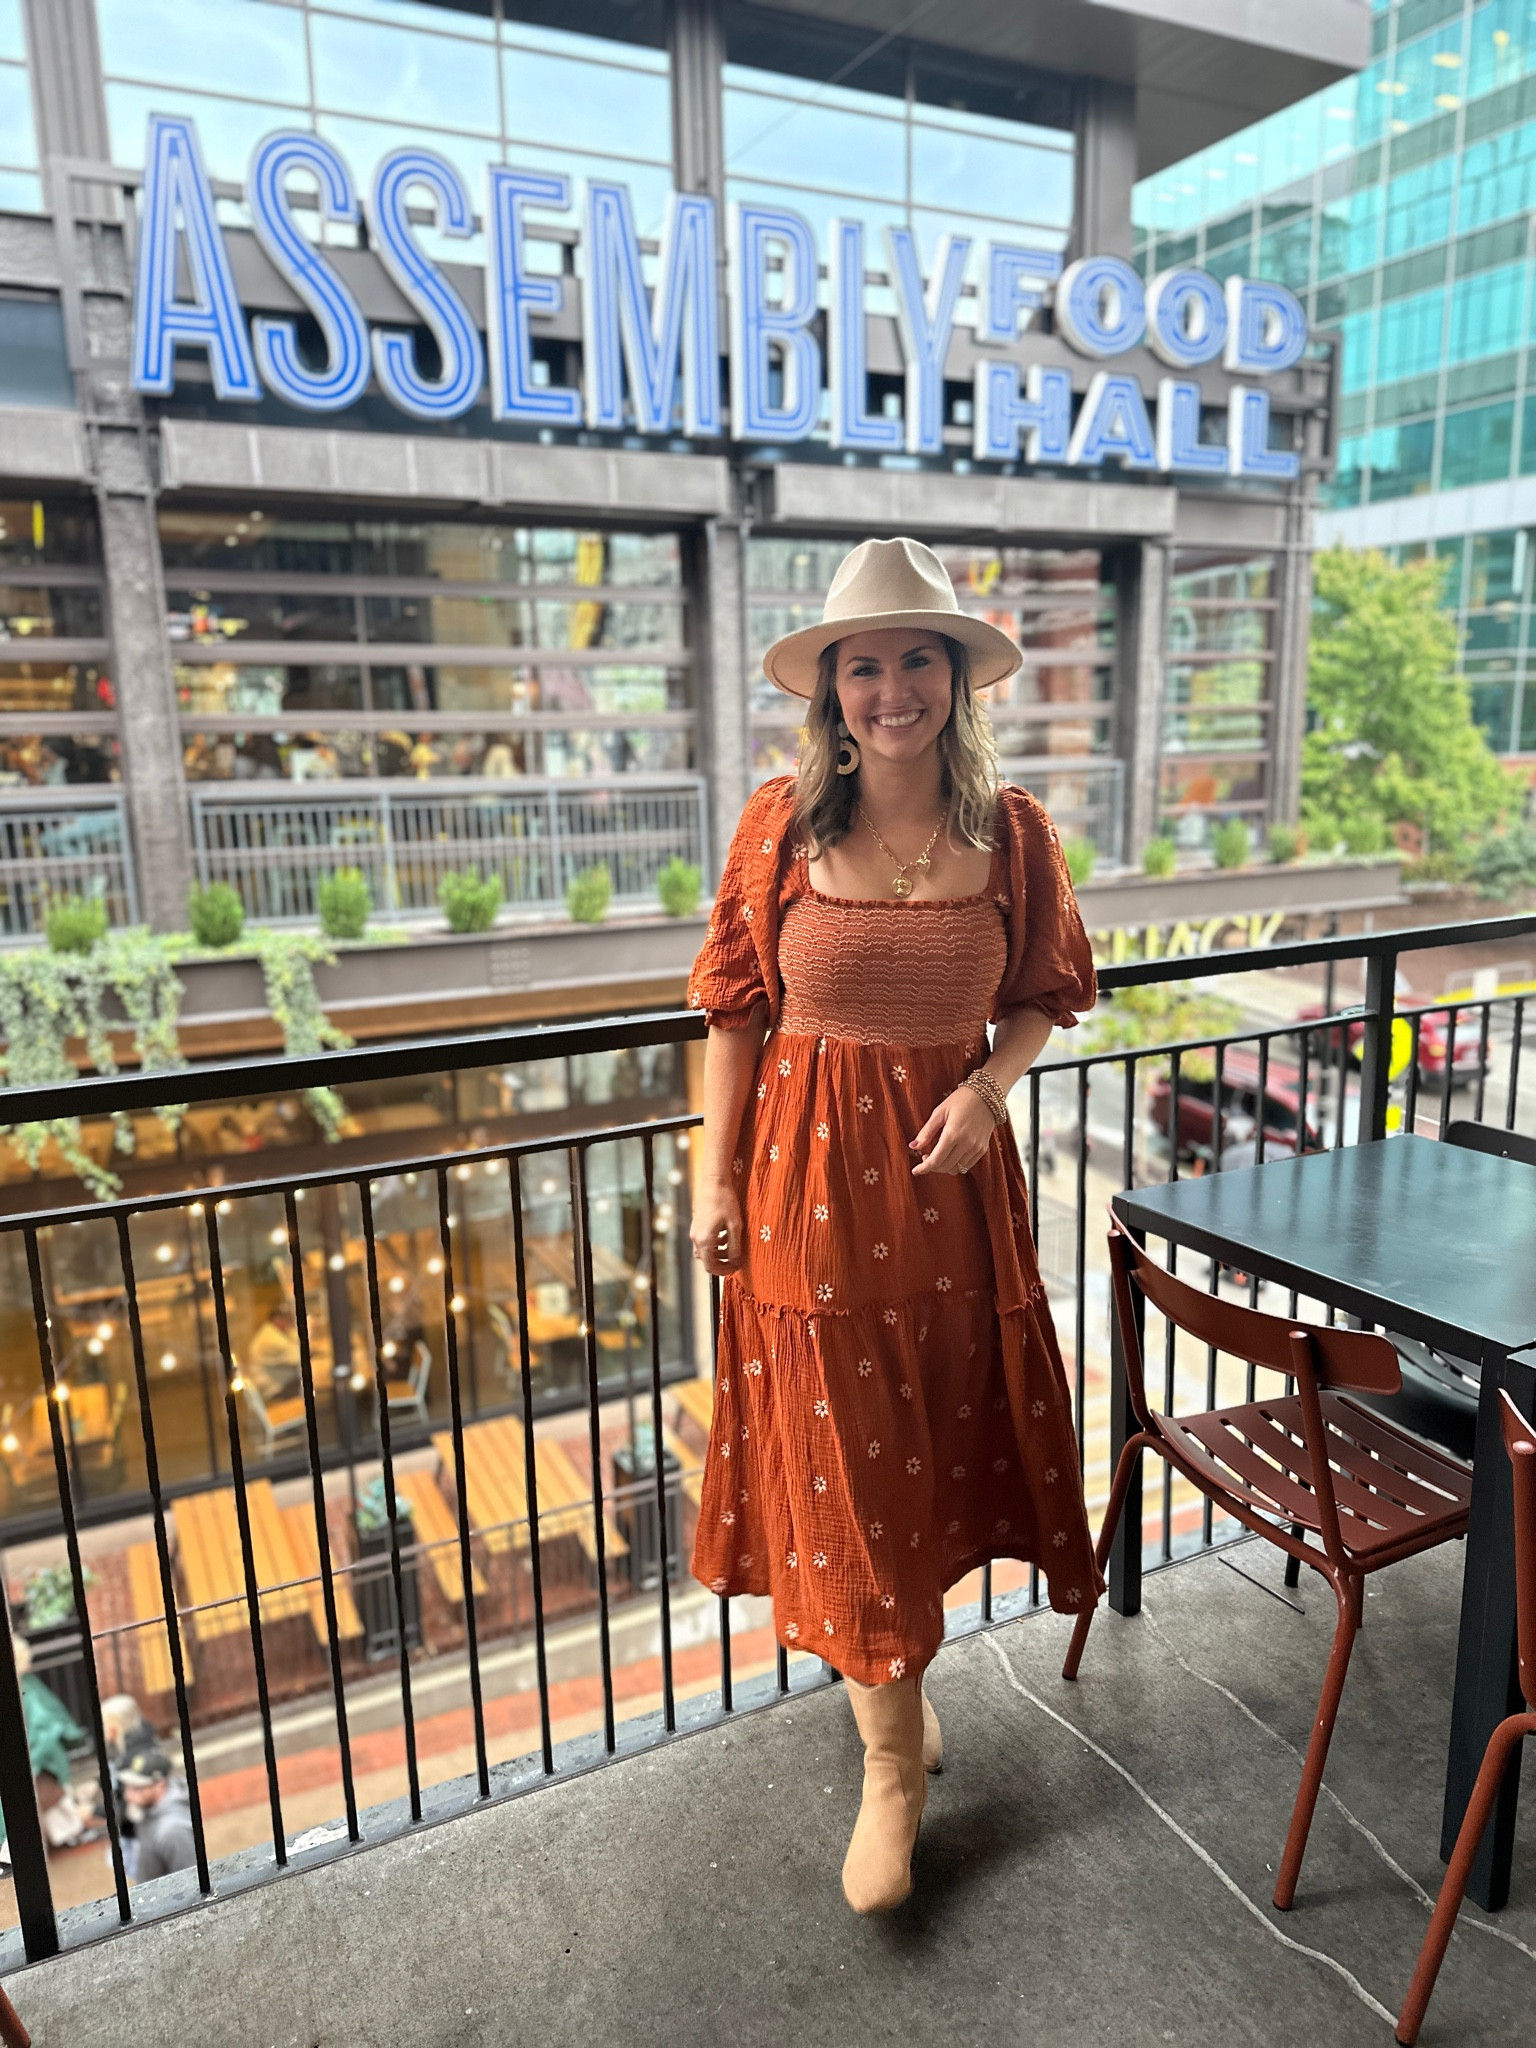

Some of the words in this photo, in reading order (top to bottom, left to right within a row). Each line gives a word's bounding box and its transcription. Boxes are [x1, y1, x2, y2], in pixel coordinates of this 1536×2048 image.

[132, 111, 971, 452] ASSEMBLY
[978, 240, 1308, 374] FOOD
[975, 360, 1301, 478] HALL
